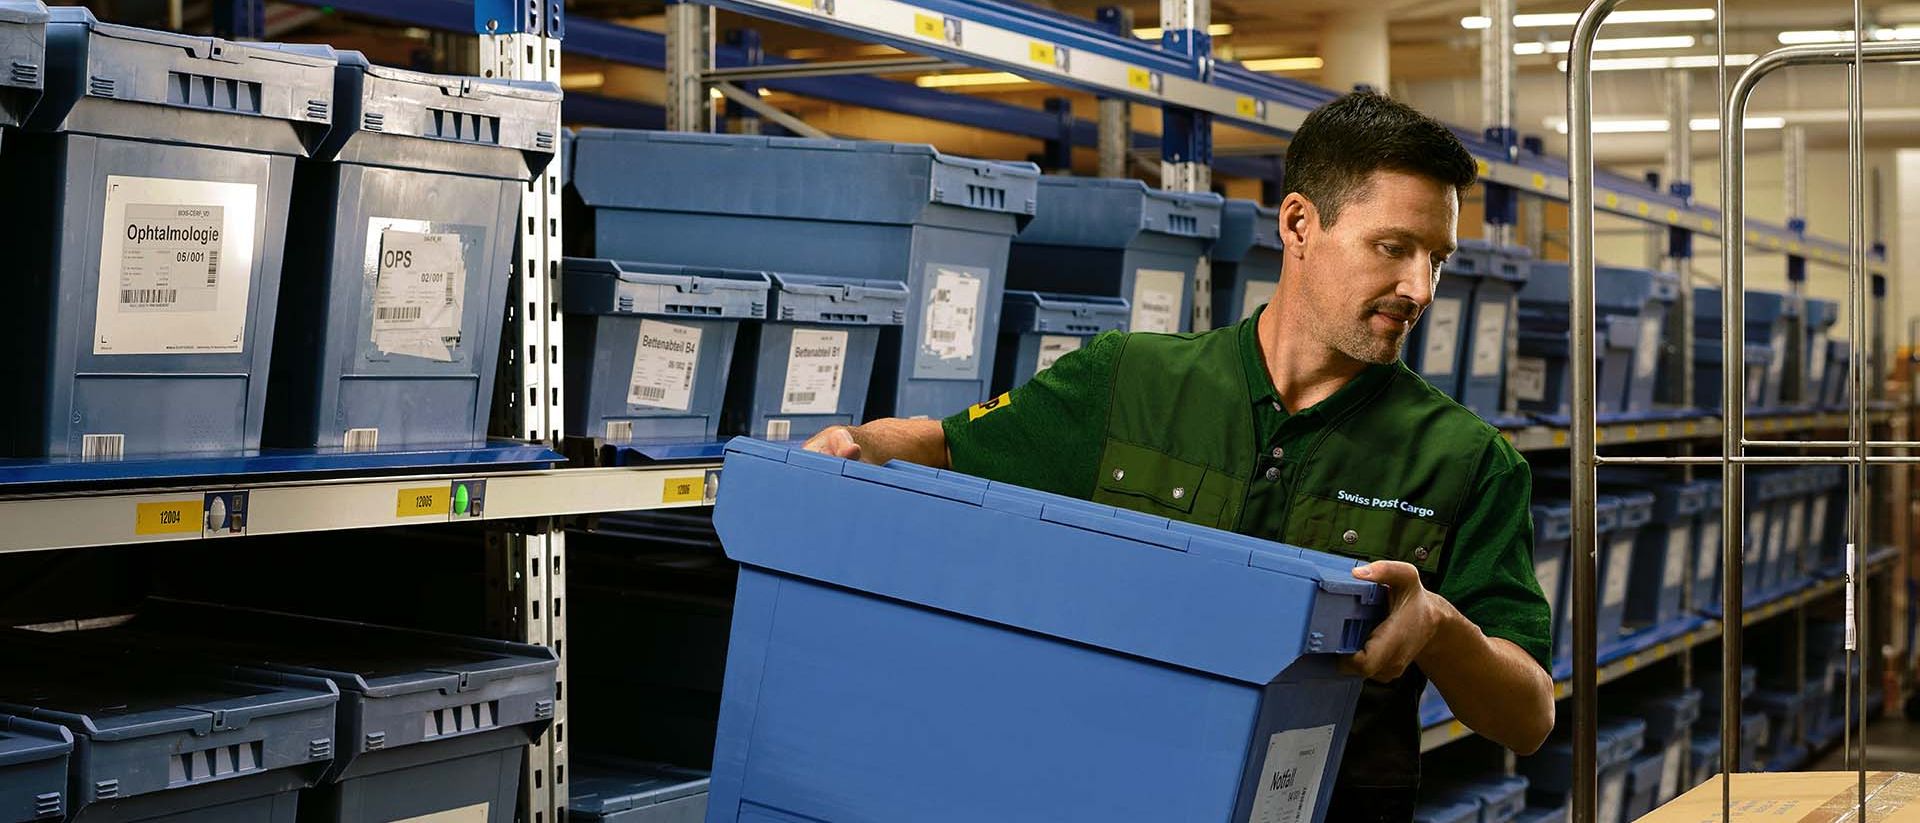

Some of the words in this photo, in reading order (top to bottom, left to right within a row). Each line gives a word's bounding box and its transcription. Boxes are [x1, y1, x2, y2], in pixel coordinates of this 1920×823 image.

[127, 224, 219, 245] Ophtalmologie
[384, 250, 412, 268] OPS
[421, 273, 443, 283] 02/001
[642, 334, 685, 353] Bettenabteil
[685, 341, 696, 354] B4
[416, 494, 432, 508] 12005
[1337, 490, 1370, 506] Swiss
[1371, 498, 1400, 509] Post
[1400, 501, 1435, 517] Cargo
[160, 510, 180, 524] 12004
[1270, 767, 1298, 791] Notfall
